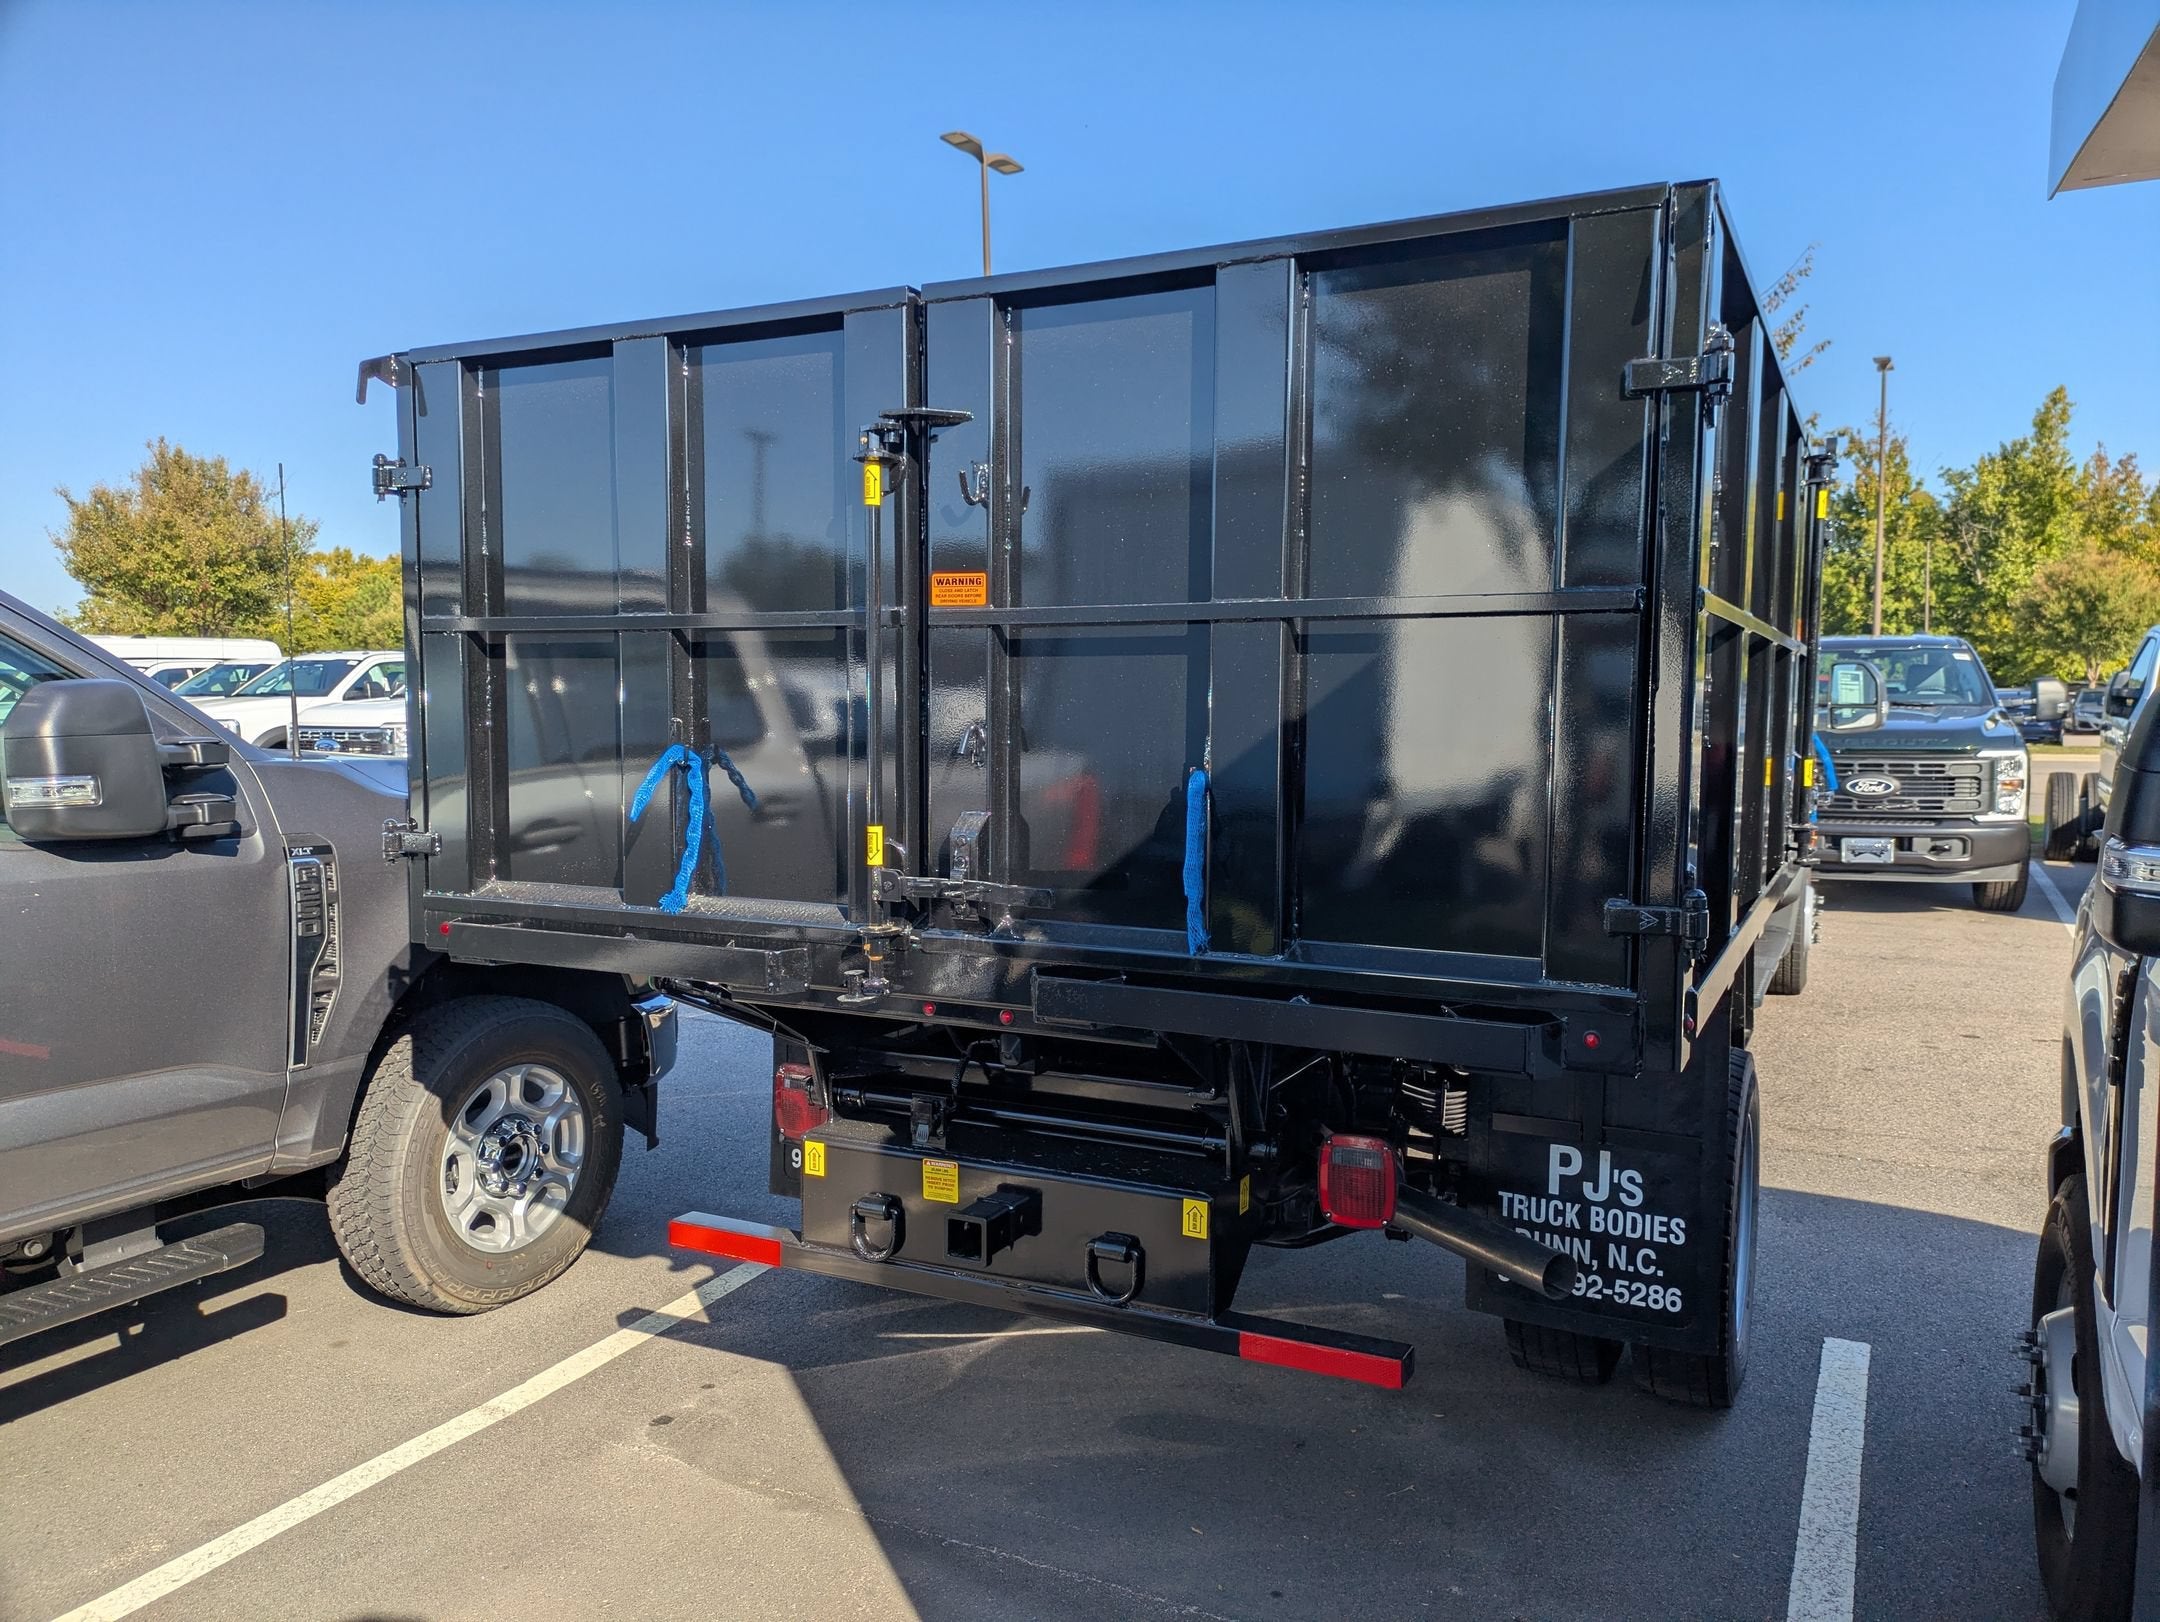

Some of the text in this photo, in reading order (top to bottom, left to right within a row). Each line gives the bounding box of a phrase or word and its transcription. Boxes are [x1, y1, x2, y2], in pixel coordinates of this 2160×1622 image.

[936, 577, 982, 586] WARNING
[290, 847, 313, 856] XLT
[791, 1148, 802, 1169] 9
[1498, 1191, 1686, 1245] TRUCK BODIES
[1608, 1243, 1664, 1277] N.C.
[1571, 1272, 1683, 1313] 92-5286
